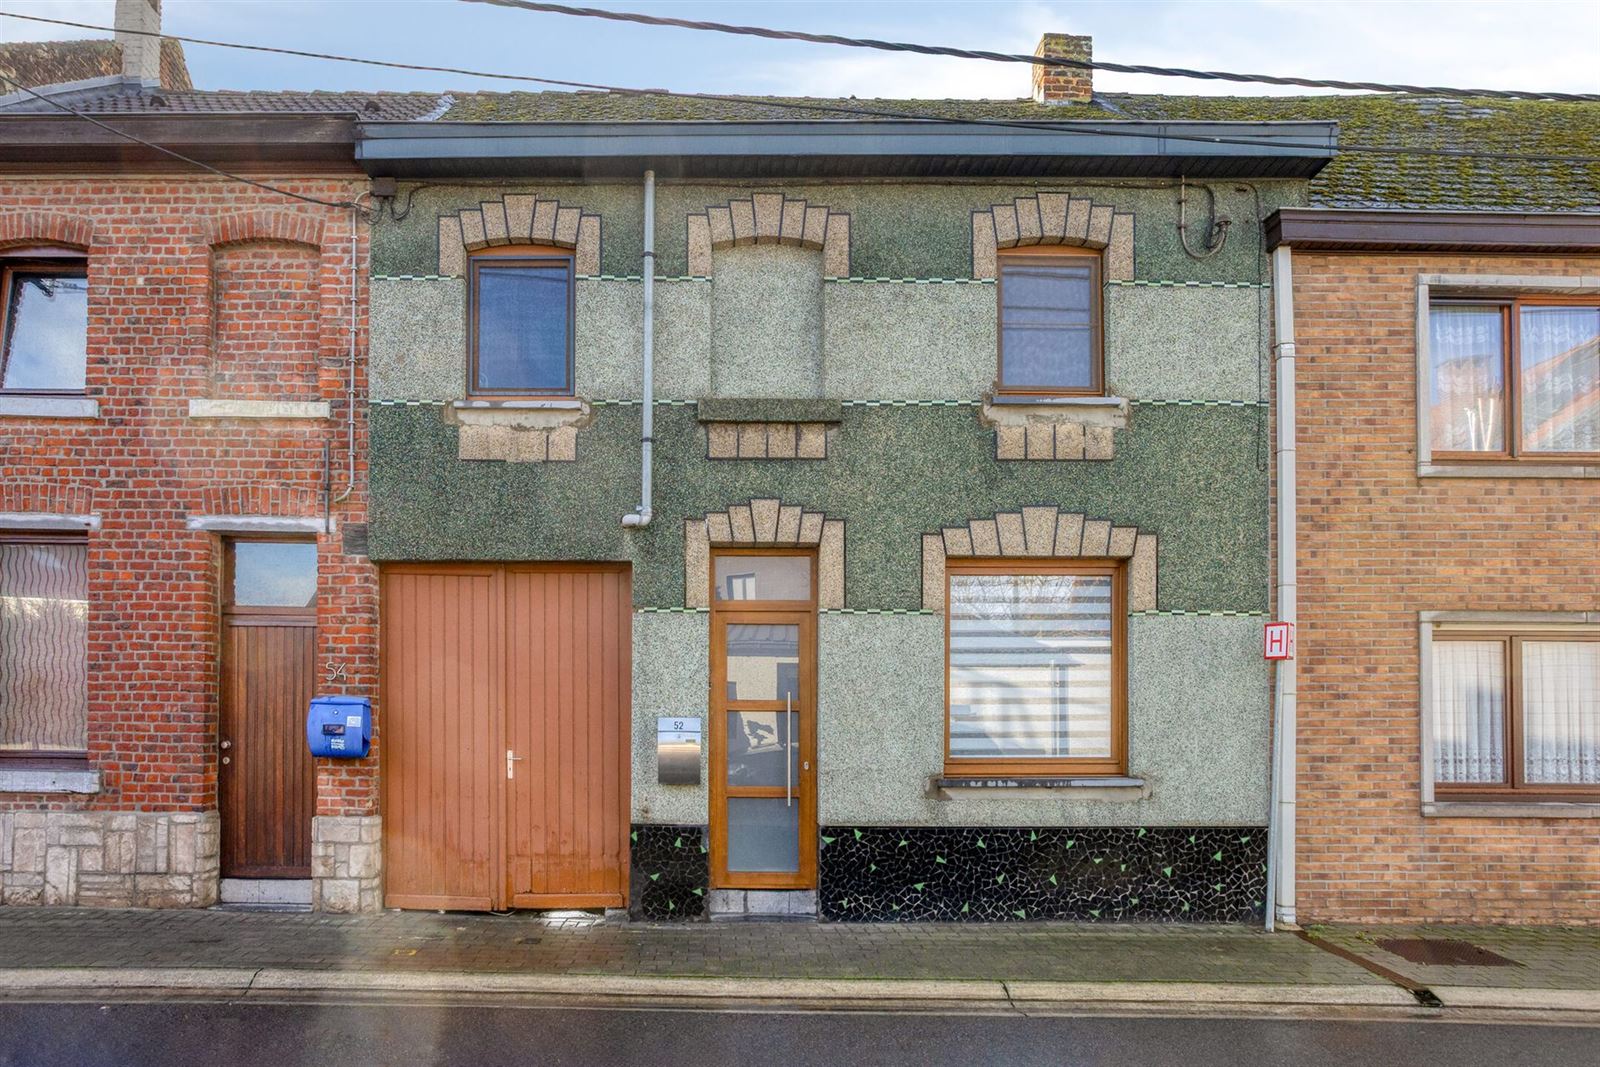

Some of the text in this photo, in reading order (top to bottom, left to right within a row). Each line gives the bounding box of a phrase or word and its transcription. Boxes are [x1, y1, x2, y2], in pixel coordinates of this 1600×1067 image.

[1270, 630, 1283, 652] H
[326, 661, 347, 681] 54
[673, 721, 684, 730] 52
